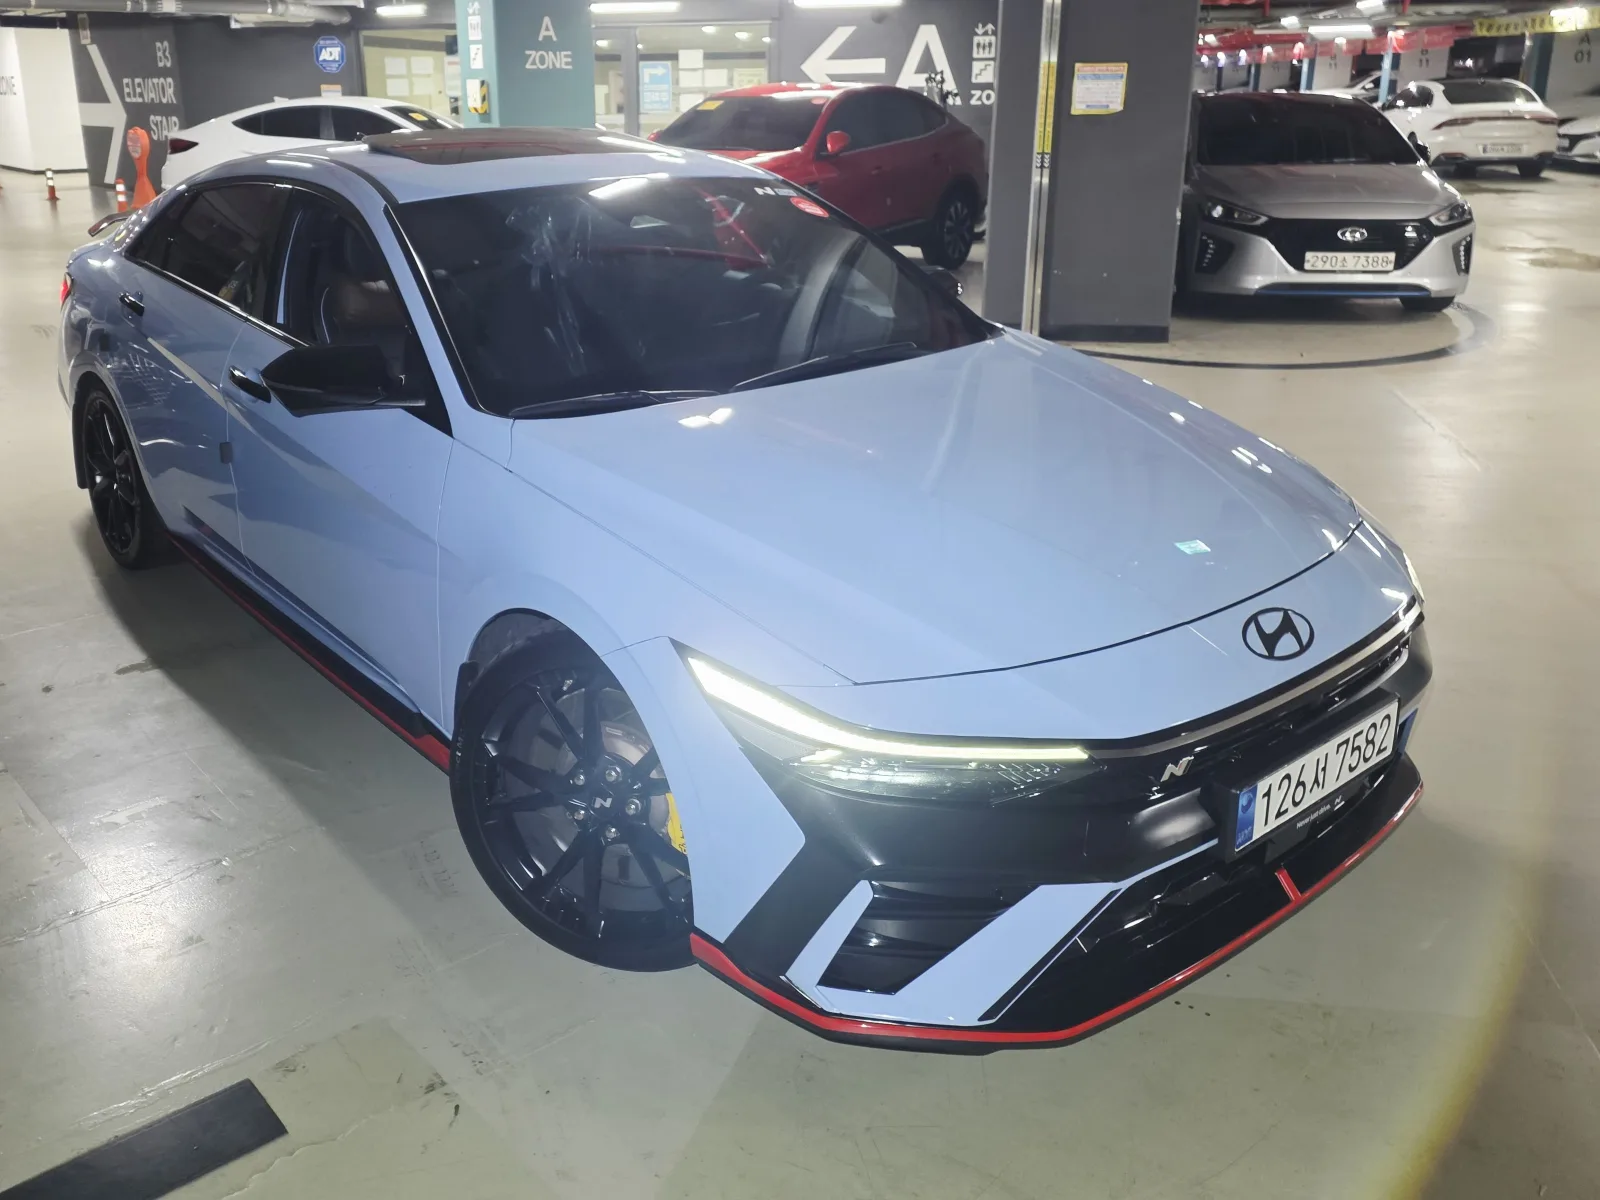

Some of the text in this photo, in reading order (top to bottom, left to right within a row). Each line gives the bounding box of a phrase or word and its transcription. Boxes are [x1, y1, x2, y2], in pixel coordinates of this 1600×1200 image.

[538, 16, 557, 41] A
[155, 41, 172, 68] B3
[319, 47, 341, 60] ADT
[525, 50, 573, 69] ZONE
[895, 24, 962, 105] A
[123, 77, 177, 104] ELEVATOR
[149, 115, 180, 141] STAIR
[1310, 255, 1390, 269] 290소 7388
[1261, 713, 1391, 827] 126서 7582
